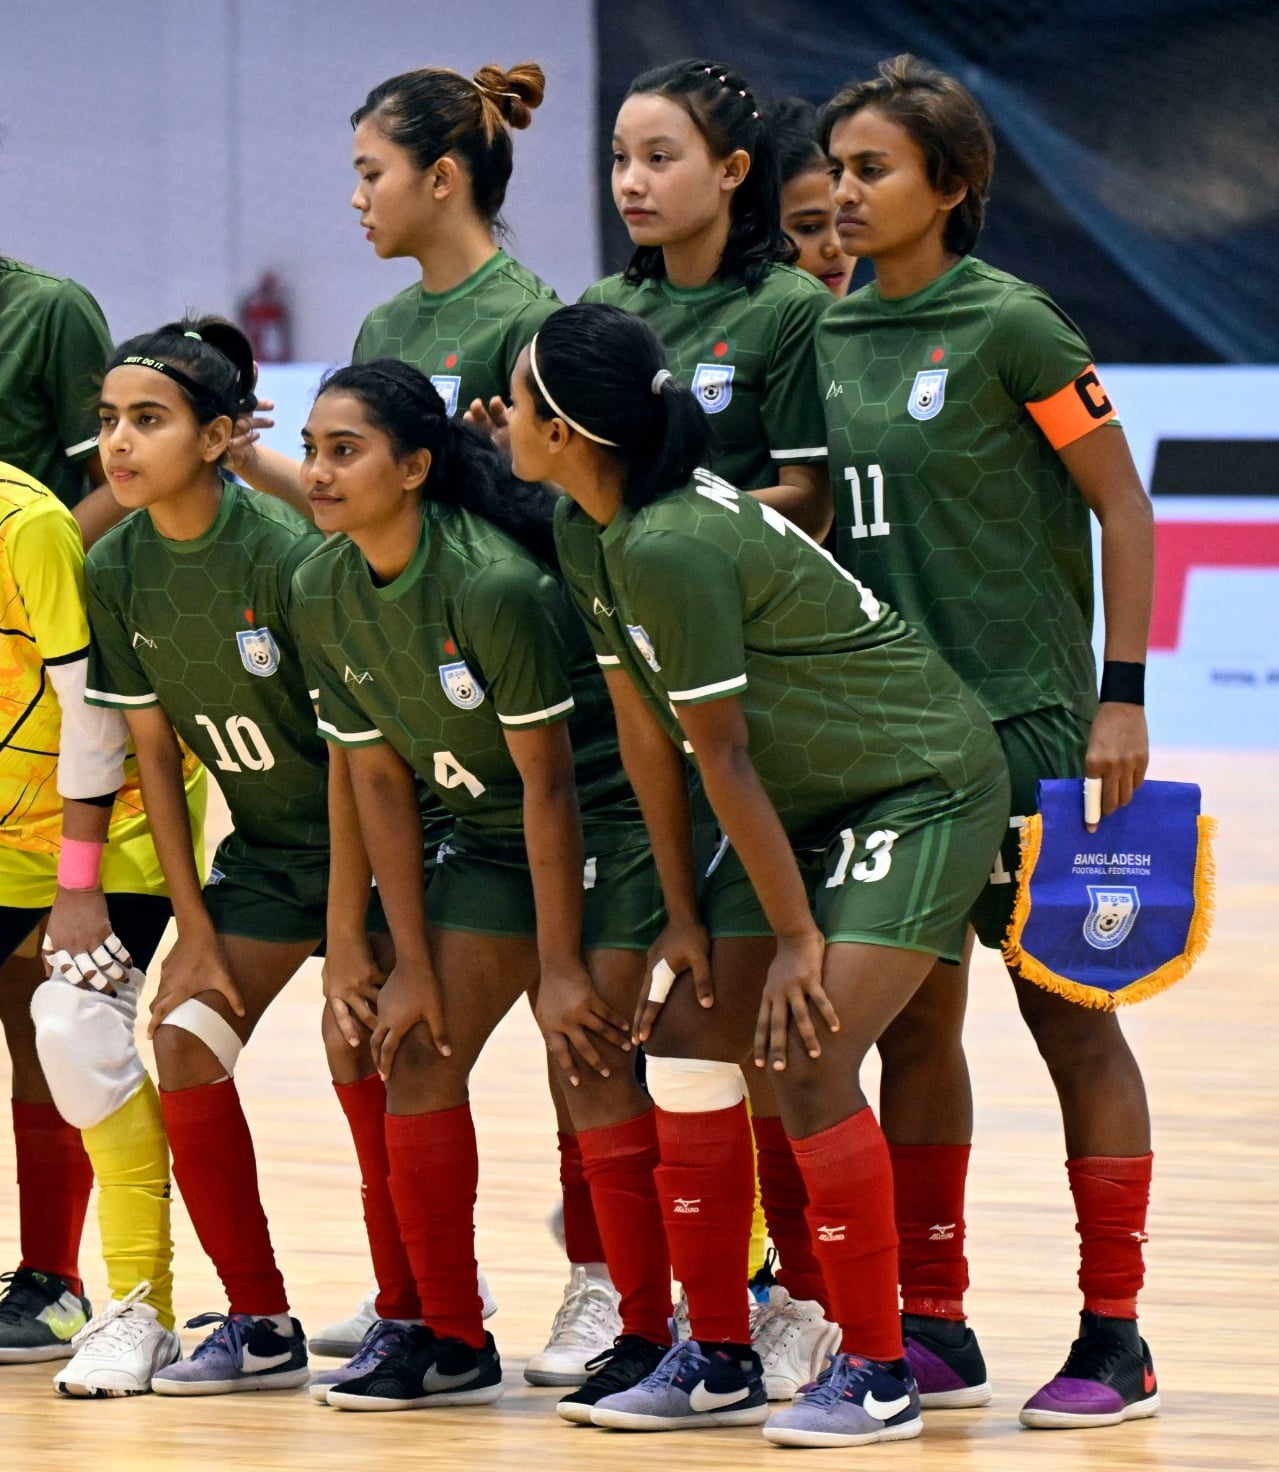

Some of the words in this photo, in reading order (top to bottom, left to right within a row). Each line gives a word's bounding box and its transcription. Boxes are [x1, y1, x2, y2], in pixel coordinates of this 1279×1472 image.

[123, 356, 143, 364] JUST
[141, 358, 156, 366] DO
[153, 362, 166, 371] IT.
[1074, 371, 1113, 419] C
[844, 464, 891, 539] 11
[195, 714, 275, 772] 10
[433, 750, 486, 798] 4
[825, 828, 900, 889] 13
[1072, 866, 1107, 875] FOOTBALL
[1107, 867, 1151, 876] FEDERATION
[1073, 853, 1151, 866] BANGLADESH
